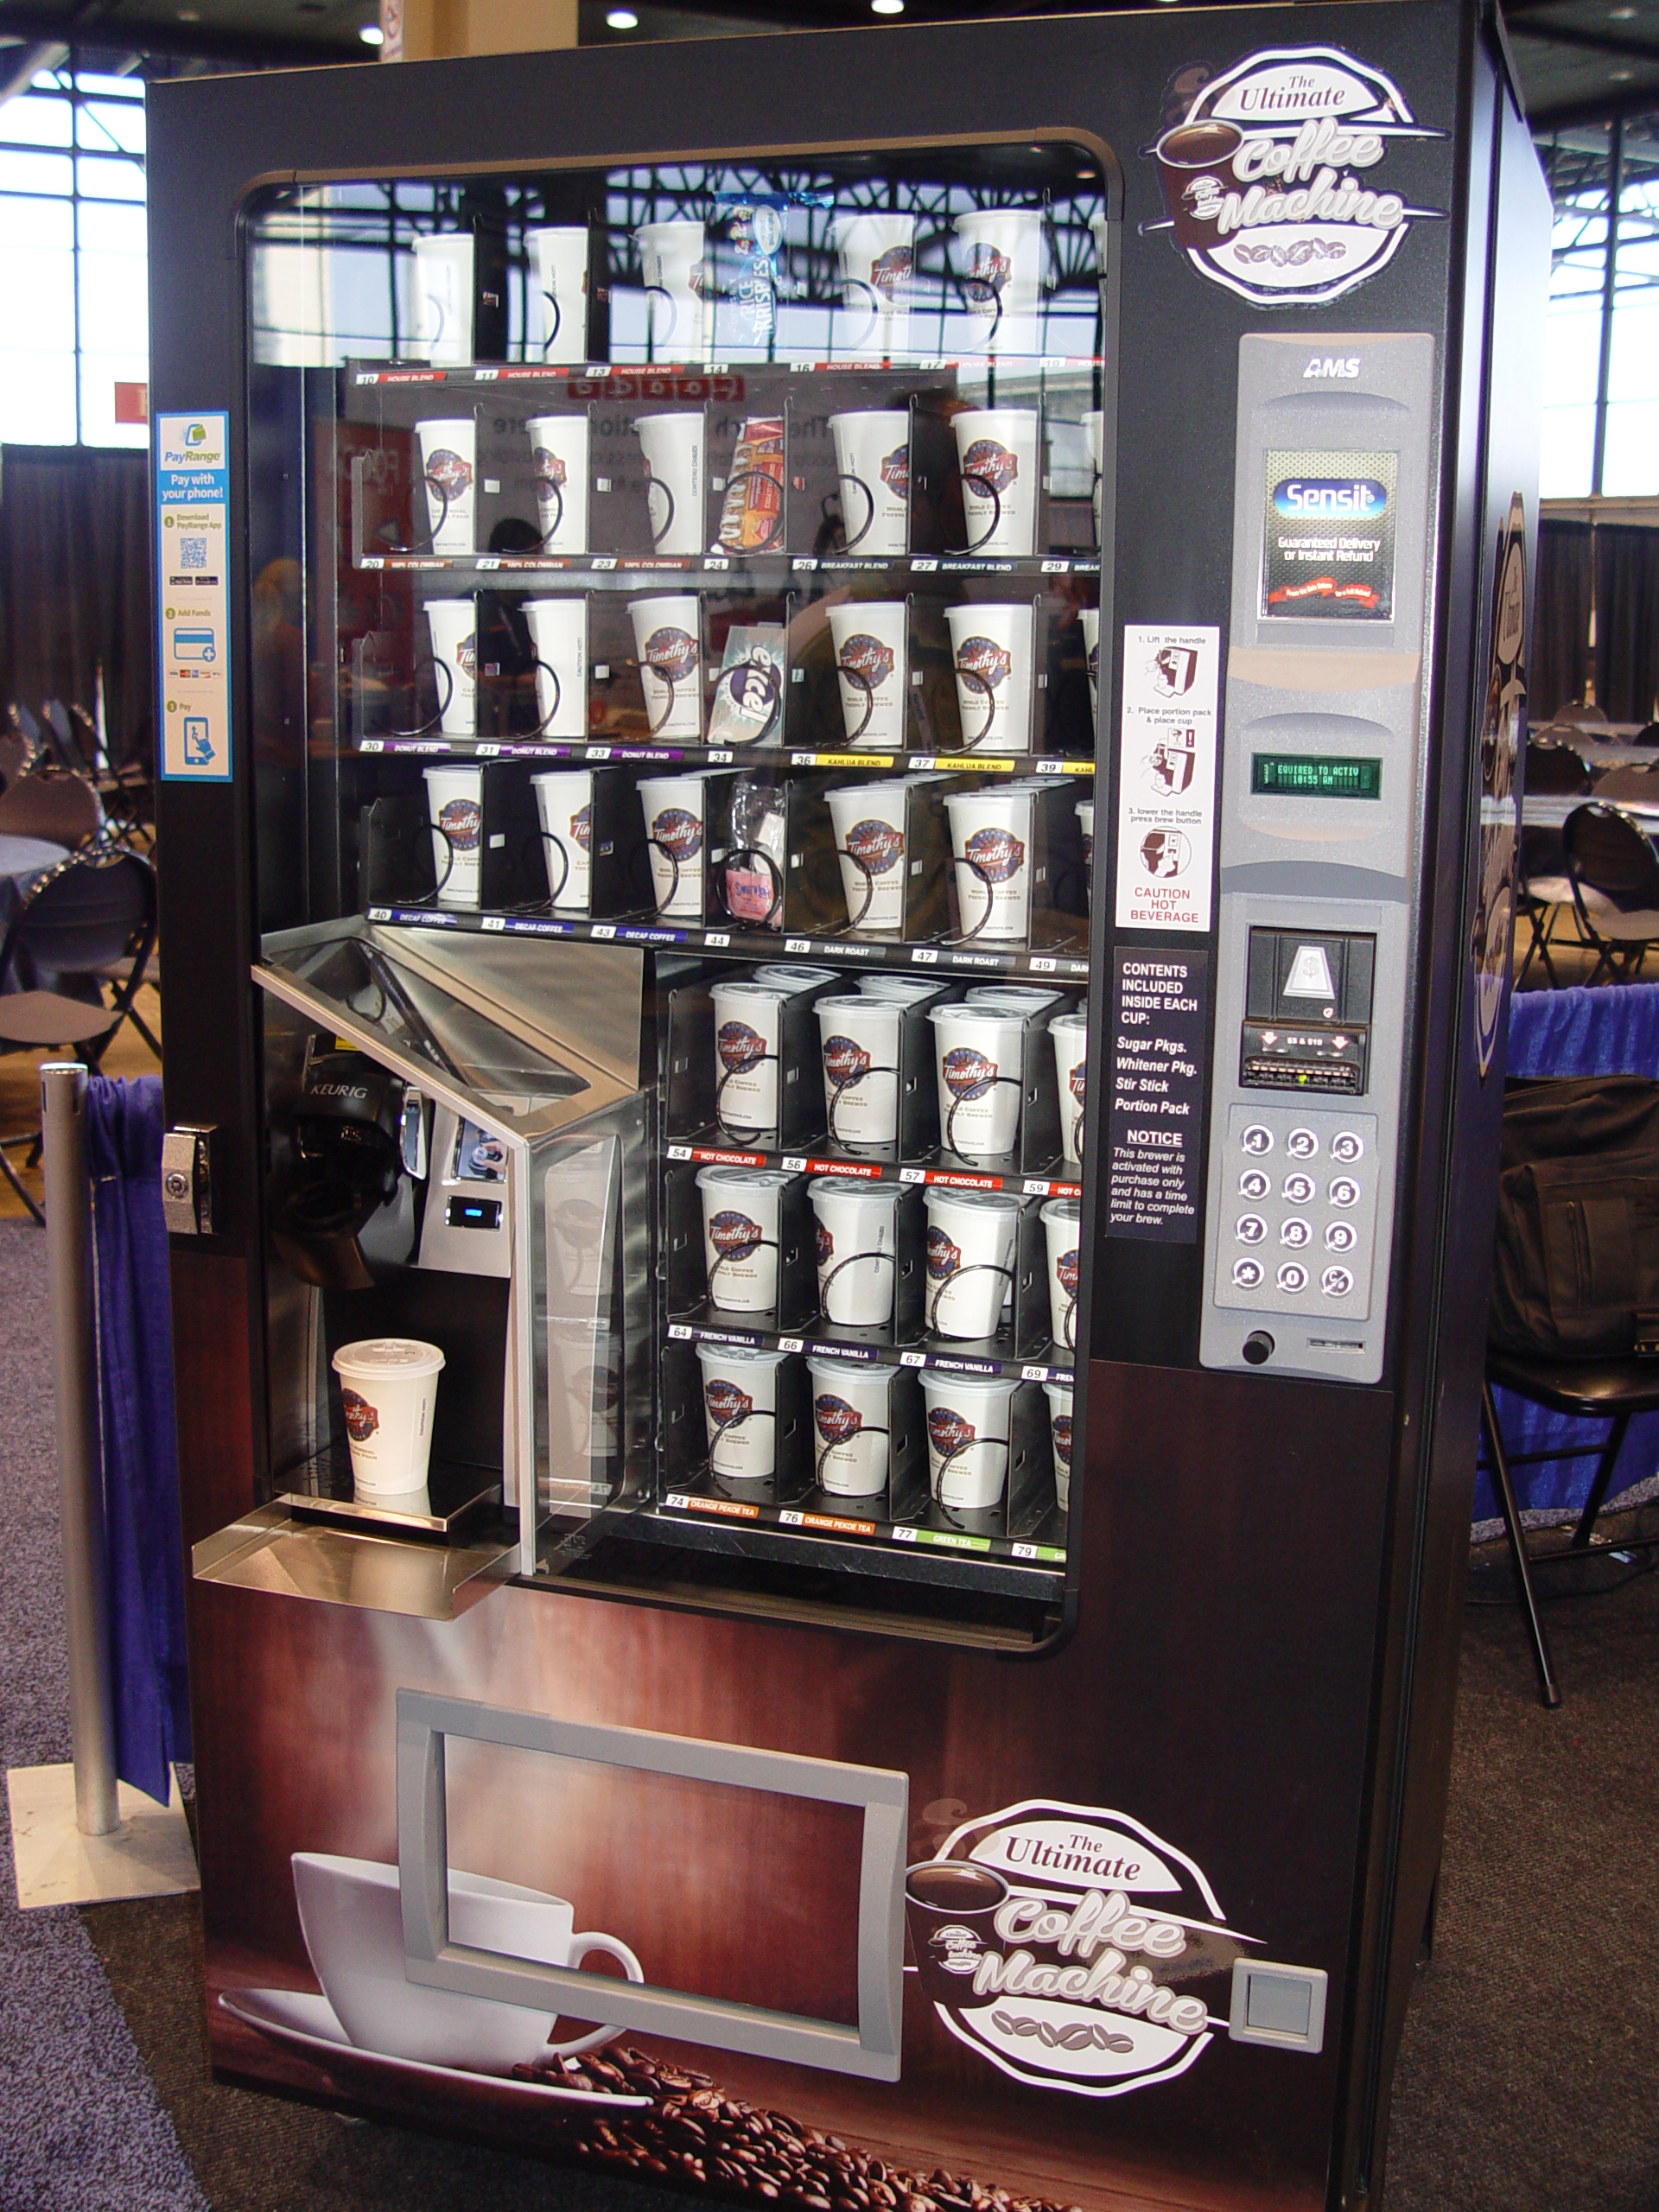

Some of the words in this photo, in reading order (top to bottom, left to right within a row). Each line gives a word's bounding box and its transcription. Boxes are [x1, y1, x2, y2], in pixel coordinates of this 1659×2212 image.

[1289, 75, 1315, 89] The
[1240, 87, 1345, 111] Ultimate
[1232, 117, 1384, 183] Coffee
[1217, 168, 1405, 235] Machine
[739, 279, 755, 317] RICE
[593, 368, 607, 377] 13
[797, 364, 810, 372] 16
[1303, 359, 1360, 378] AMS
[164, 451, 220, 464] PayRange
[171, 474, 189, 487] Pay
[191, 473, 215, 485] with
[162, 489, 186, 502] your
[187, 486, 223, 501] phone!
[1287, 484, 1371, 512] Sensit
[1278, 537, 1337, 550] Guaranteed
[1338, 537, 1381, 552] Delivery
[1284, 550, 1296, 561] or
[1298, 550, 1335, 562] Instant
[1336, 550, 1374, 562] Refund
[798, 562, 812, 570] 26
[917, 562, 932, 570] 27
[647, 639, 697, 663] Timothy's
[842, 648, 889, 673] Timothy's
[958, 650, 1007, 675] Timothy's
[914, 760, 929, 768] 37
[1278, 765, 1313, 776] EQUIRED
[1319, 766, 1329, 776] TO
[1333, 766, 1359, 777] ACTIV
[1323, 776, 1333, 785] AM
[1176, 809, 1203, 817] handle
[848, 833, 900, 857] Timothy's
[967, 841, 1021, 865] Timothy's
[1135, 887, 1191, 899] CAUTION
[1151, 899, 1177, 910] HOT
[1130, 910, 1199, 924] BEVERAGE
[597, 929, 610, 938] 43
[649, 933, 675, 942] COFFEE
[918, 951, 932, 961] 47
[953, 956, 973, 964] DARK
[975, 957, 999, 967] ROAST
[1122, 963, 1188, 978] CONTENTS
[1122, 979, 1184, 994] INCLUDED
[1122, 995, 1161, 1009] INSIDE
[1163, 997, 1198, 1012] EACH
[1121, 1011, 1150, 1025] CUP:
[718, 1036, 763, 1059] Timothy's
[1116, 1036, 1153, 1053] Sugar
[1154, 1038, 1187, 1055] Pkgs.
[823, 1049, 867, 1072] Timothy's
[1116, 1057, 1170, 1072] Whitener
[1171, 1060, 1198, 1077] Pkg.
[944, 1061, 995, 1082] Timothy's
[311, 1084, 368, 1099] KEURIG
[1116, 1077, 1137, 1090] Stir
[1139, 1078, 1170, 1093] Stick
[1115, 1098, 1158, 1113] Portion
[1160, 1101, 1191, 1116] Pack
[1127, 1129, 1183, 1145] NOTICE
[672, 1148, 686, 1158] 54
[716, 1154, 757, 1165] CHOCOLATE
[1114, 1147, 1135, 1159] This
[1137, 1149, 1174, 1162] brewer
[1176, 1152, 1185, 1162] is
[787, 1160, 801, 1169] 56
[830, 1165, 871, 1176] CHOCOLATE
[1112, 1161, 1160, 1173] activated
[1161, 1165, 1183, 1175] with
[906, 1172, 919, 1180] 57
[950, 1176, 993, 1188] CHOCOLATE
[1111, 1174, 1160, 1186] purchase
[1162, 1178, 1185, 1190] only
[1029, 1183, 1043, 1192] 59
[1058, 1186, 1072, 1195] HOT
[1111, 1186, 1132, 1197] and
[1134, 1187, 1153, 1198] has
[1165, 1191, 1188, 1202] time
[1110, 1198, 1132, 1210] limit
[1135, 1200, 1145, 1211] to
[1147, 1202, 1195, 1215] complete
[1109, 1212, 1134, 1224] your
[1135, 1213, 1164, 1225] brew.
[711, 1224, 759, 1243] Timothy's
[673, 1327, 686, 1337] 64
[700, 1332, 728, 1341] FRENCH
[728, 1334, 755, 1344] VANILLA
[784, 1340, 798, 1350] 66
[812, 1345, 840, 1355] FRENCH
[841, 1348, 868, 1359] VANILLA
[906, 1355, 919, 1364] 67
[935, 1359, 964, 1370] FRENCH
[964, 1362, 993, 1373] VANILLA
[1027, 1369, 1041, 1378] 69
[706, 1393, 749, 1415] Timothy's
[671, 1497, 683, 1506] 74
[690, 1500, 718, 1511] ORANGE
[718, 1503, 740, 1514] PEKOE
[741, 1507, 754, 1516] TEA
[785, 1512, 798, 1522] 76
[804, 1516, 832, 1528] ORANGE
[833, 1520, 856, 1530] PEKOE
[857, 1523, 871, 1533] TEA
[899, 1529, 912, 1539] 77
[933, 1535, 957, 1545] GREEN
[957, 1537, 971, 1547] TEA
[1018, 1546, 1032, 1556] 79
[1070, 1834, 1103, 1853] The
[1006, 1835, 1141, 1882] Ultimate
[994, 1889, 1187, 1956] Coffee
[972, 1948, 1208, 2034] Machine
